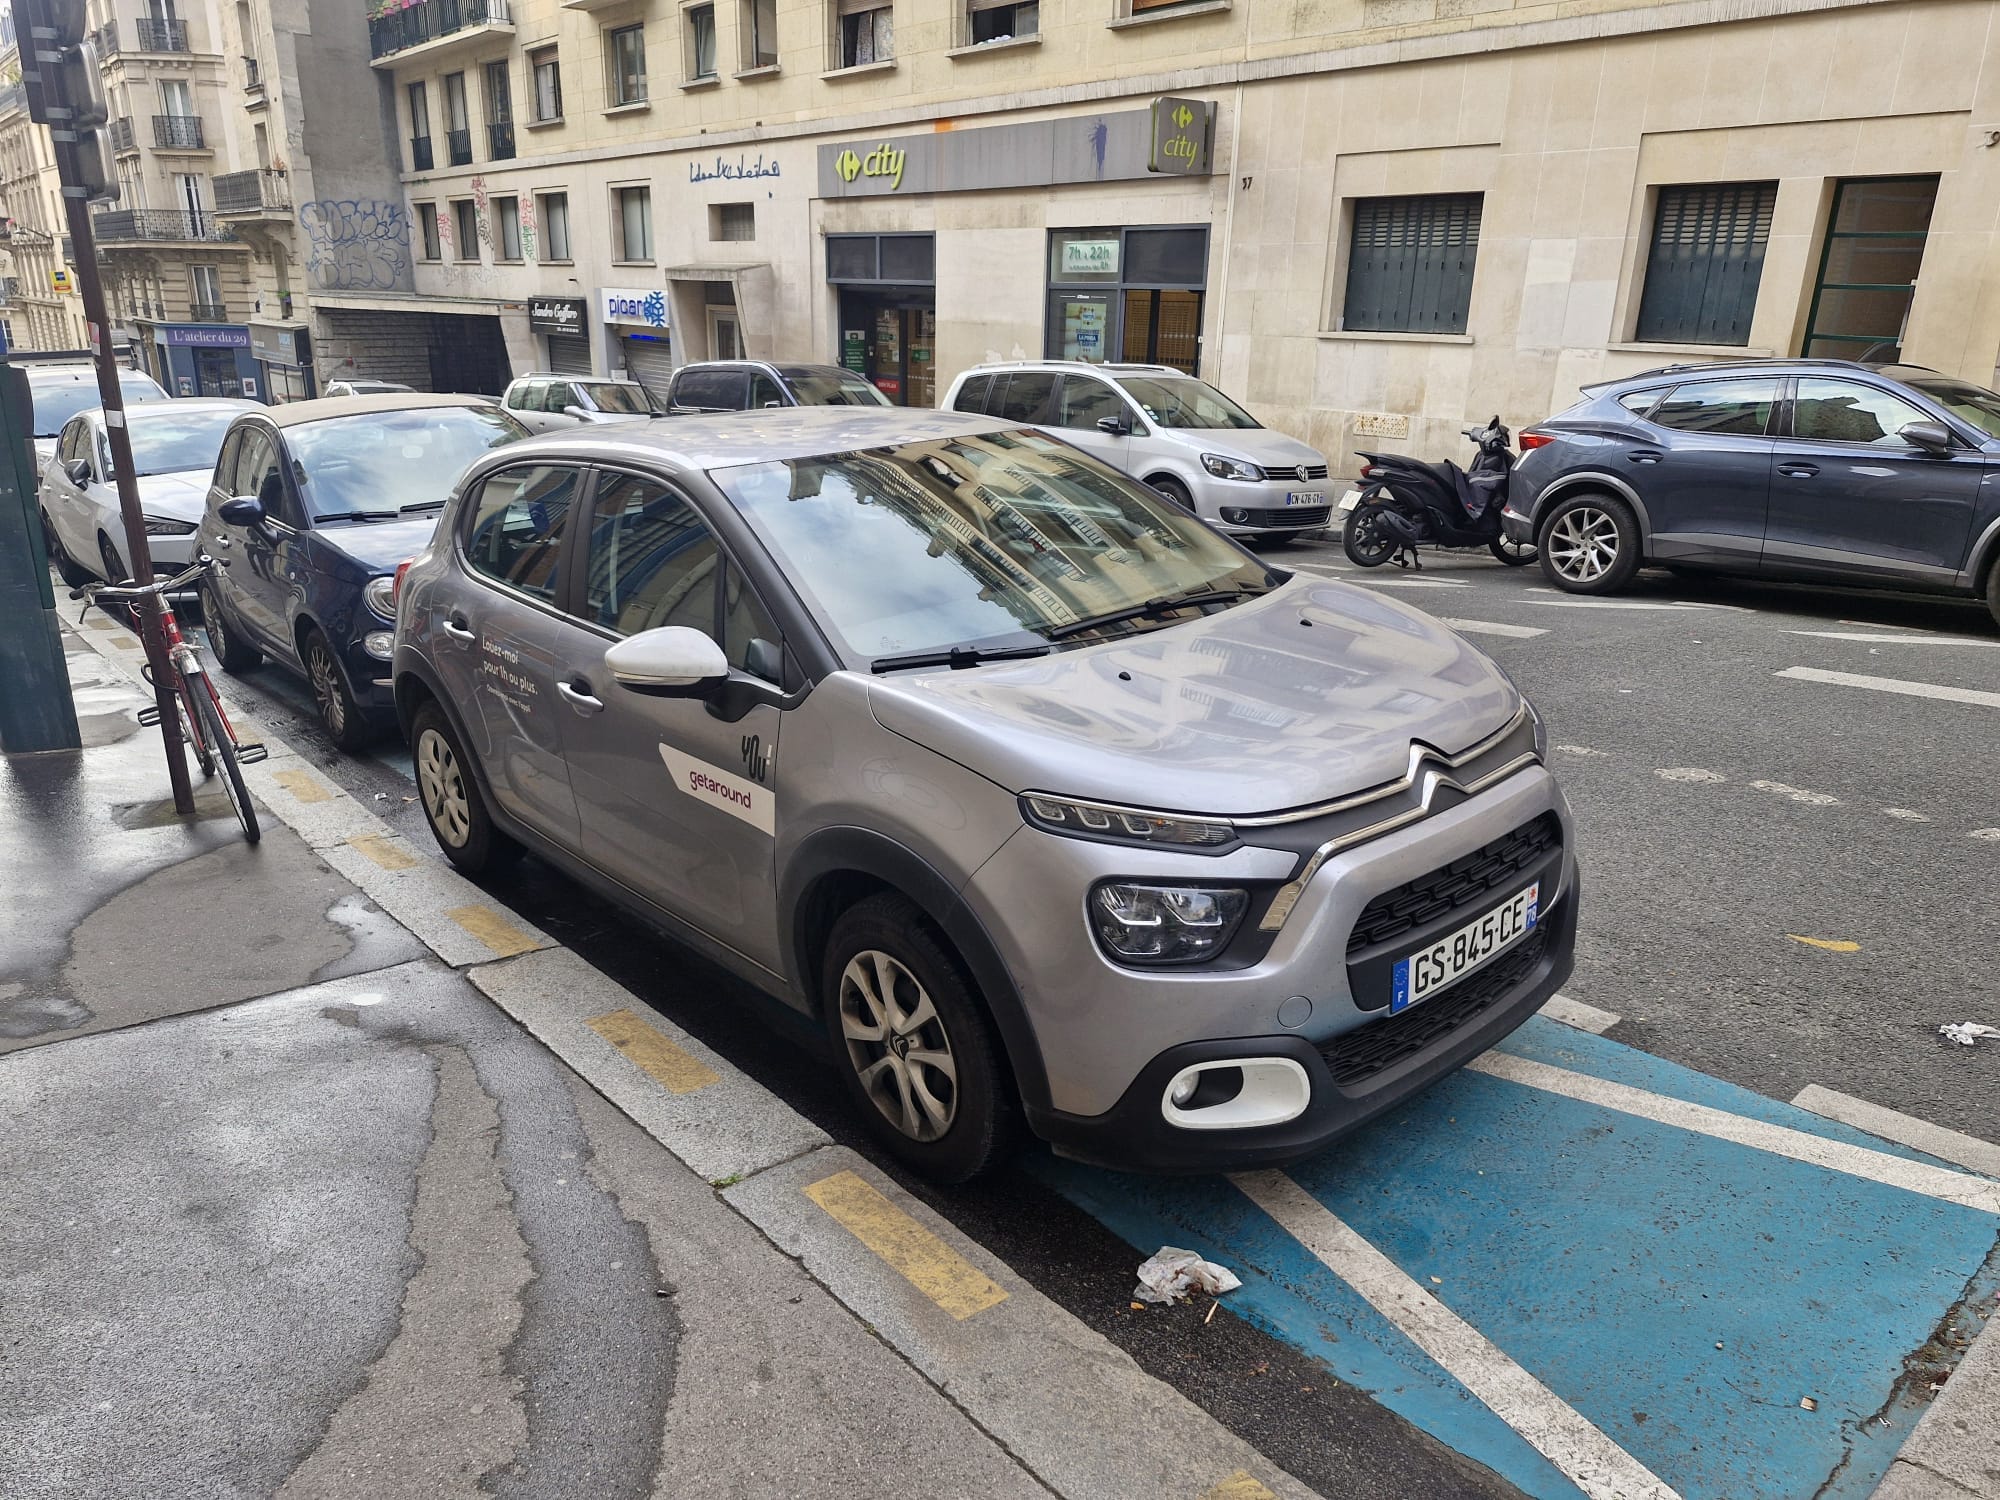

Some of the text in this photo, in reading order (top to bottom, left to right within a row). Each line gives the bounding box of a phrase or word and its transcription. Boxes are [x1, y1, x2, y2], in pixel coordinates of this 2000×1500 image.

[1164, 135, 1197, 170] city
[863, 143, 905, 190] city
[1090, 246, 1110, 260] 22h
[174, 330, 217, 343] L'atelier
[218, 331, 232, 344] du
[233, 334, 247, 345] 29
[483, 660, 499, 676] pour
[500, 664, 508, 681] 1h
[509, 672, 519, 686] ou
[689, 770, 752, 810] getaround
[1527, 904, 1537, 924] 78
[1397, 990, 1405, 1003] F
